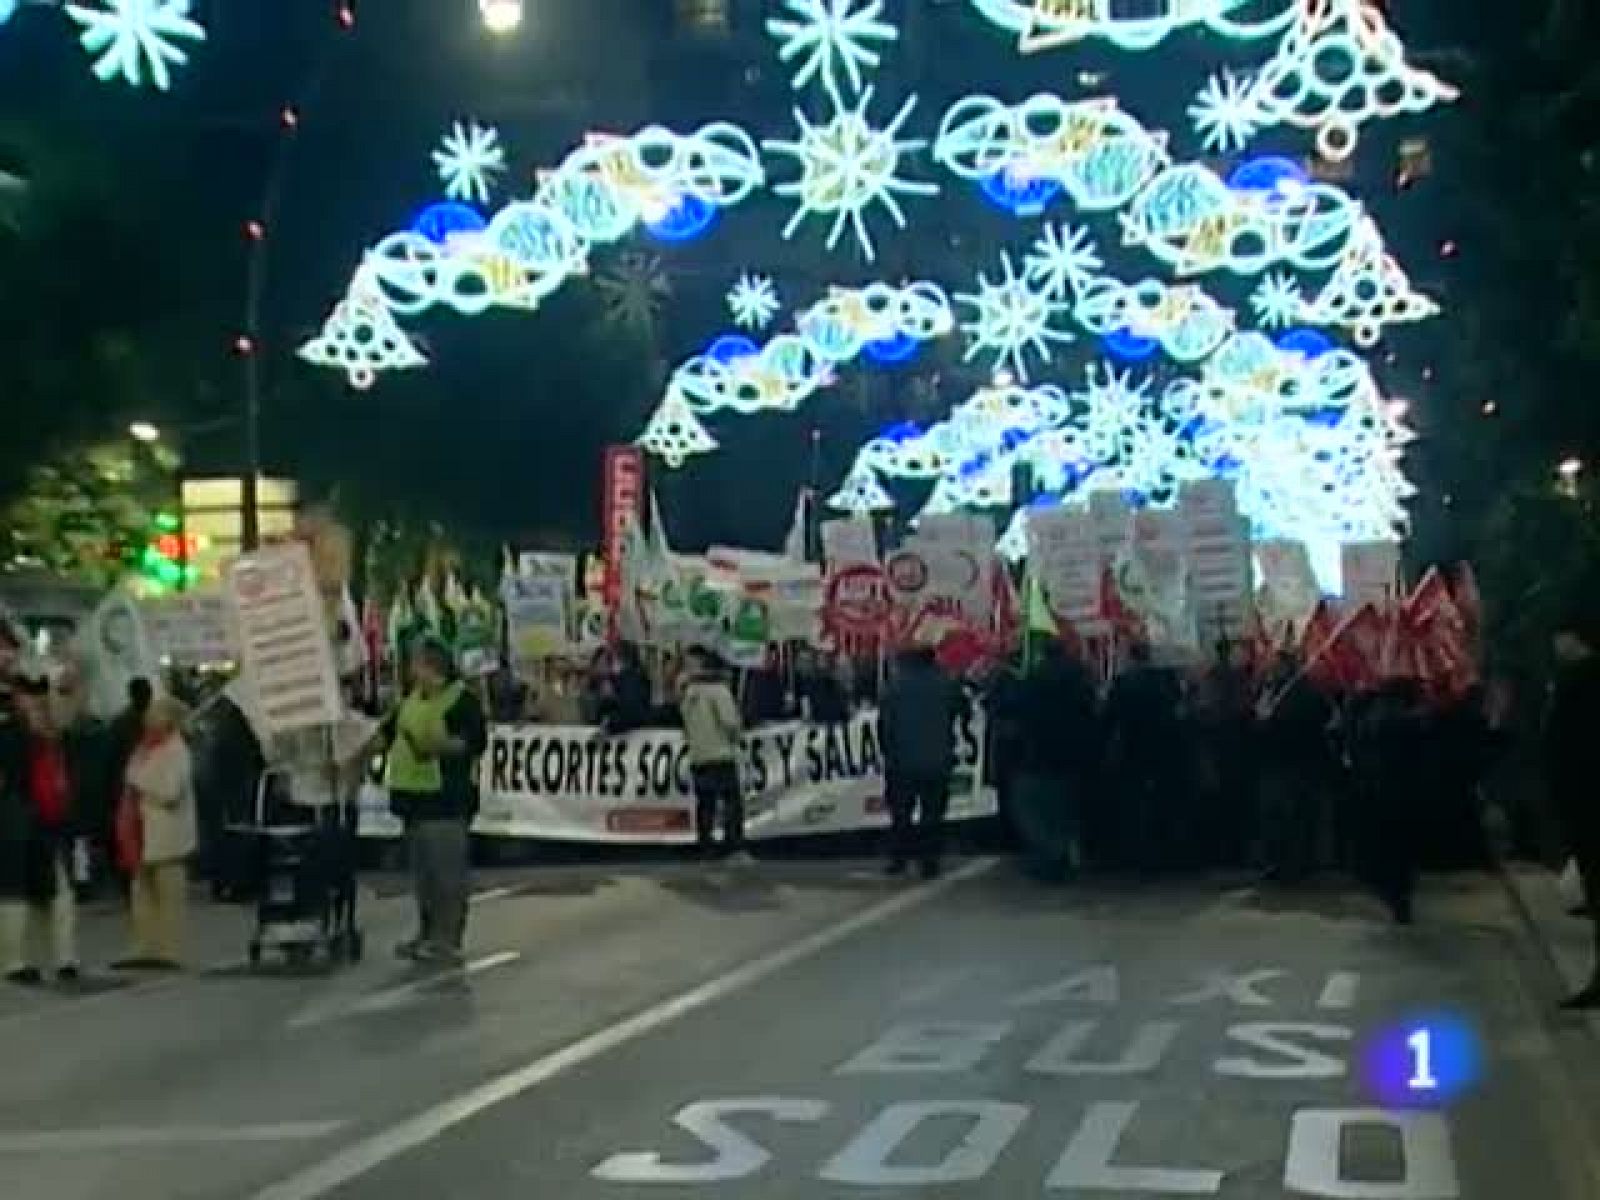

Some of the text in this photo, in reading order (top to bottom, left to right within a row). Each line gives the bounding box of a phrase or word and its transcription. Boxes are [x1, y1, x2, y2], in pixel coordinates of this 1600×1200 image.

[492, 736, 627, 796] RECORTES
[775, 733, 794, 788] Y
[838, 1020, 1353, 1078] BUS
[589, 1098, 1460, 1198] SOLO
